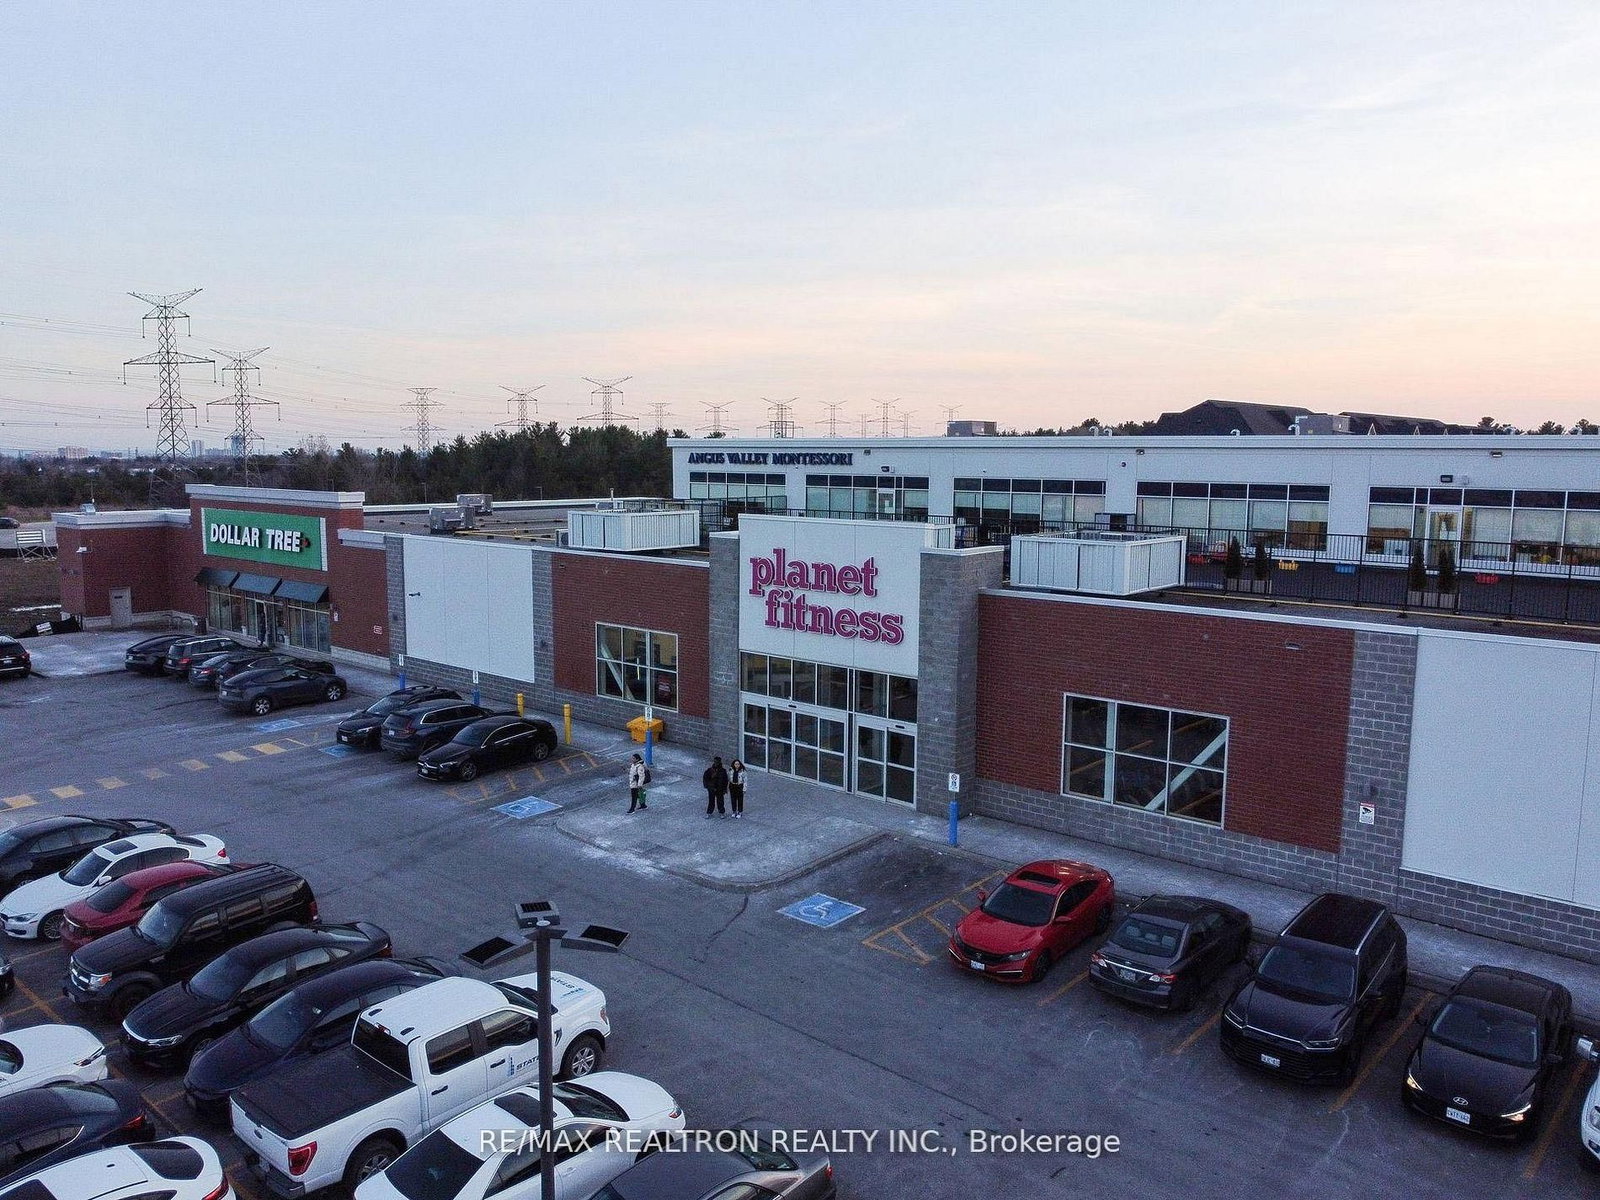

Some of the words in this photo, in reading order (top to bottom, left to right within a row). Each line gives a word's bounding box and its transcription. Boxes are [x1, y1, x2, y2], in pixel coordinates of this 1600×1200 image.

[688, 452, 725, 464] ANGUS
[726, 452, 769, 465] VALLEY
[771, 452, 853, 466] MONTESSORI
[210, 523, 260, 548] DOLLAR
[265, 528, 301, 553] TREE
[749, 548, 878, 598] planet
[765, 588, 904, 645] fitness
